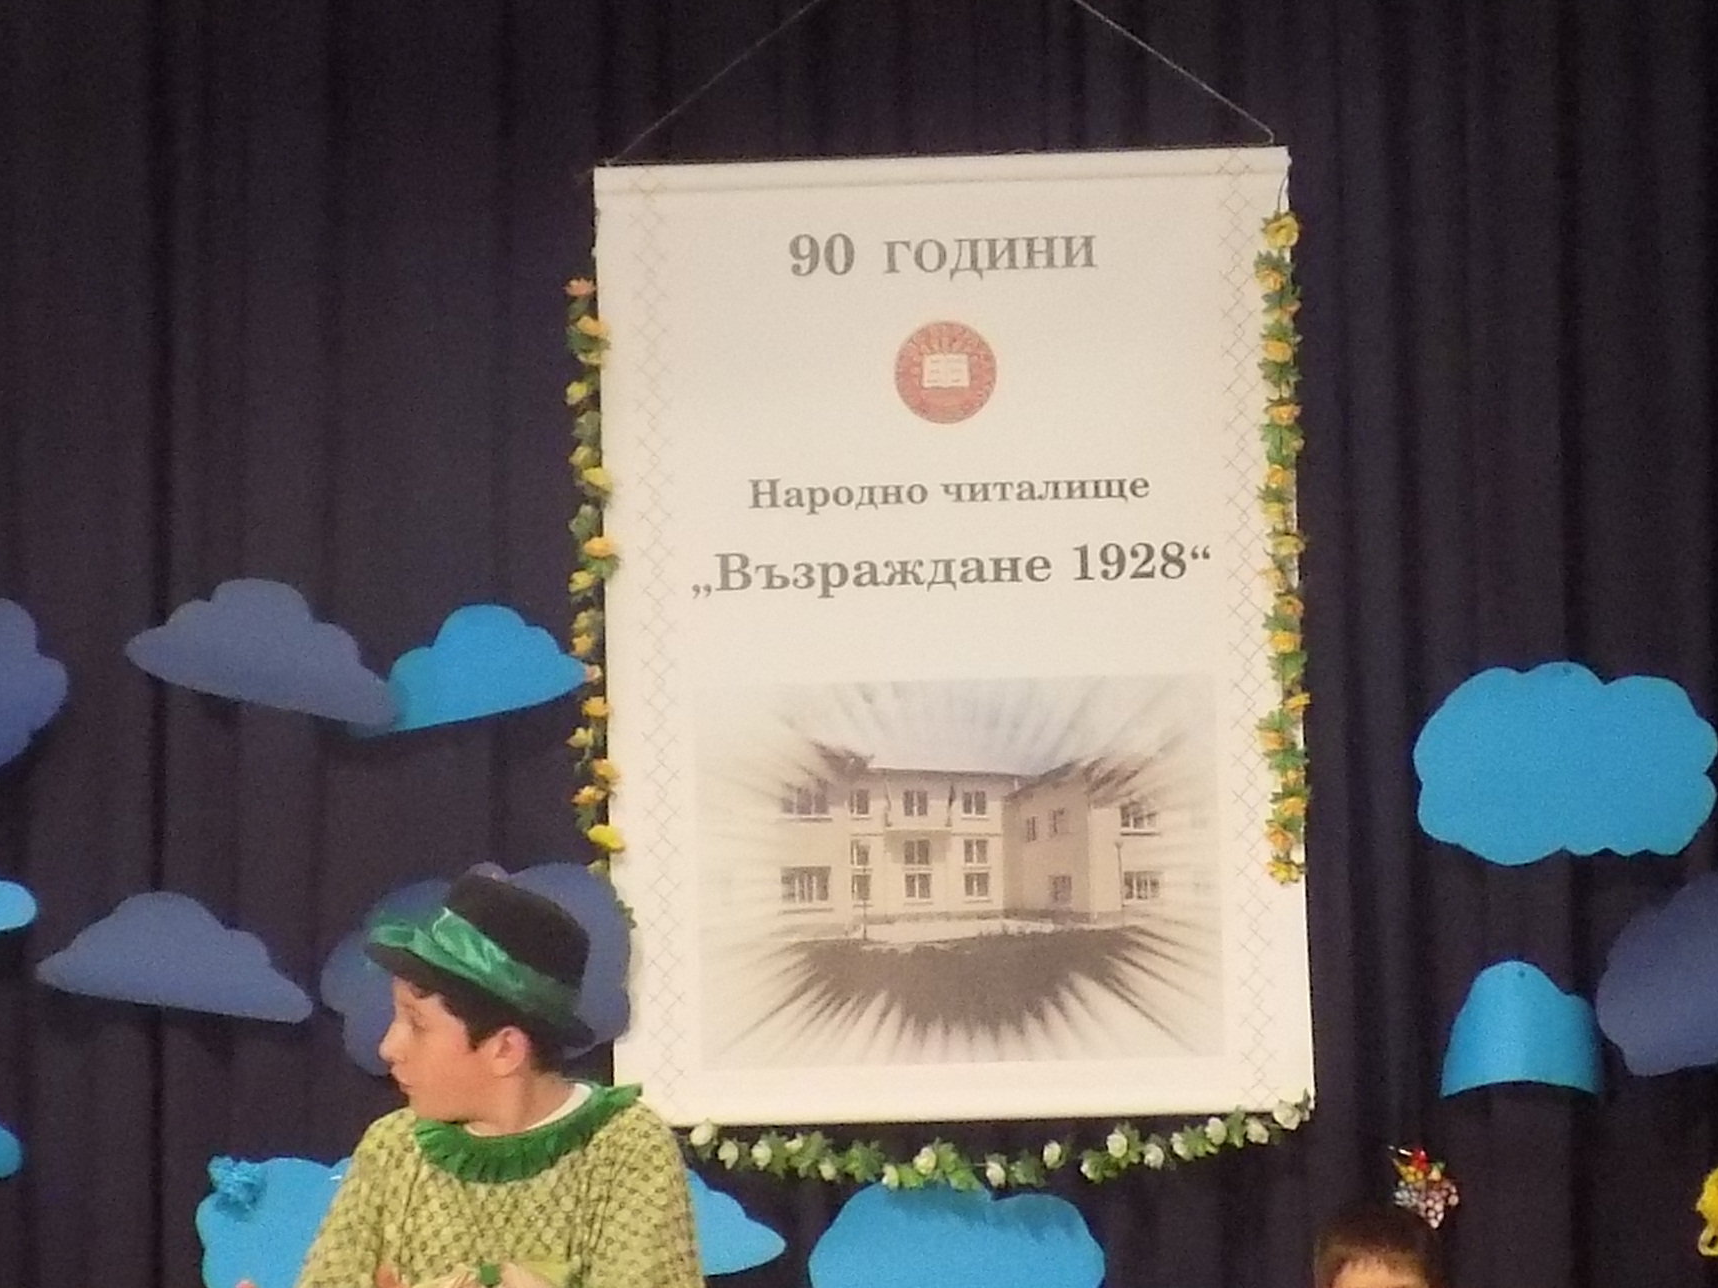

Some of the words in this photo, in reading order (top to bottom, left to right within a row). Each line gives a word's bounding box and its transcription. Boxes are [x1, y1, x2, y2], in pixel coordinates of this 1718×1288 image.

[788, 232, 856, 278] 90
[883, 234, 1098, 281] години
[748, 478, 930, 516] Народно
[940, 476, 1151, 504] читалище
[690, 551, 1053, 600] „Възраждане
[1071, 540, 1212, 582] 1928“
